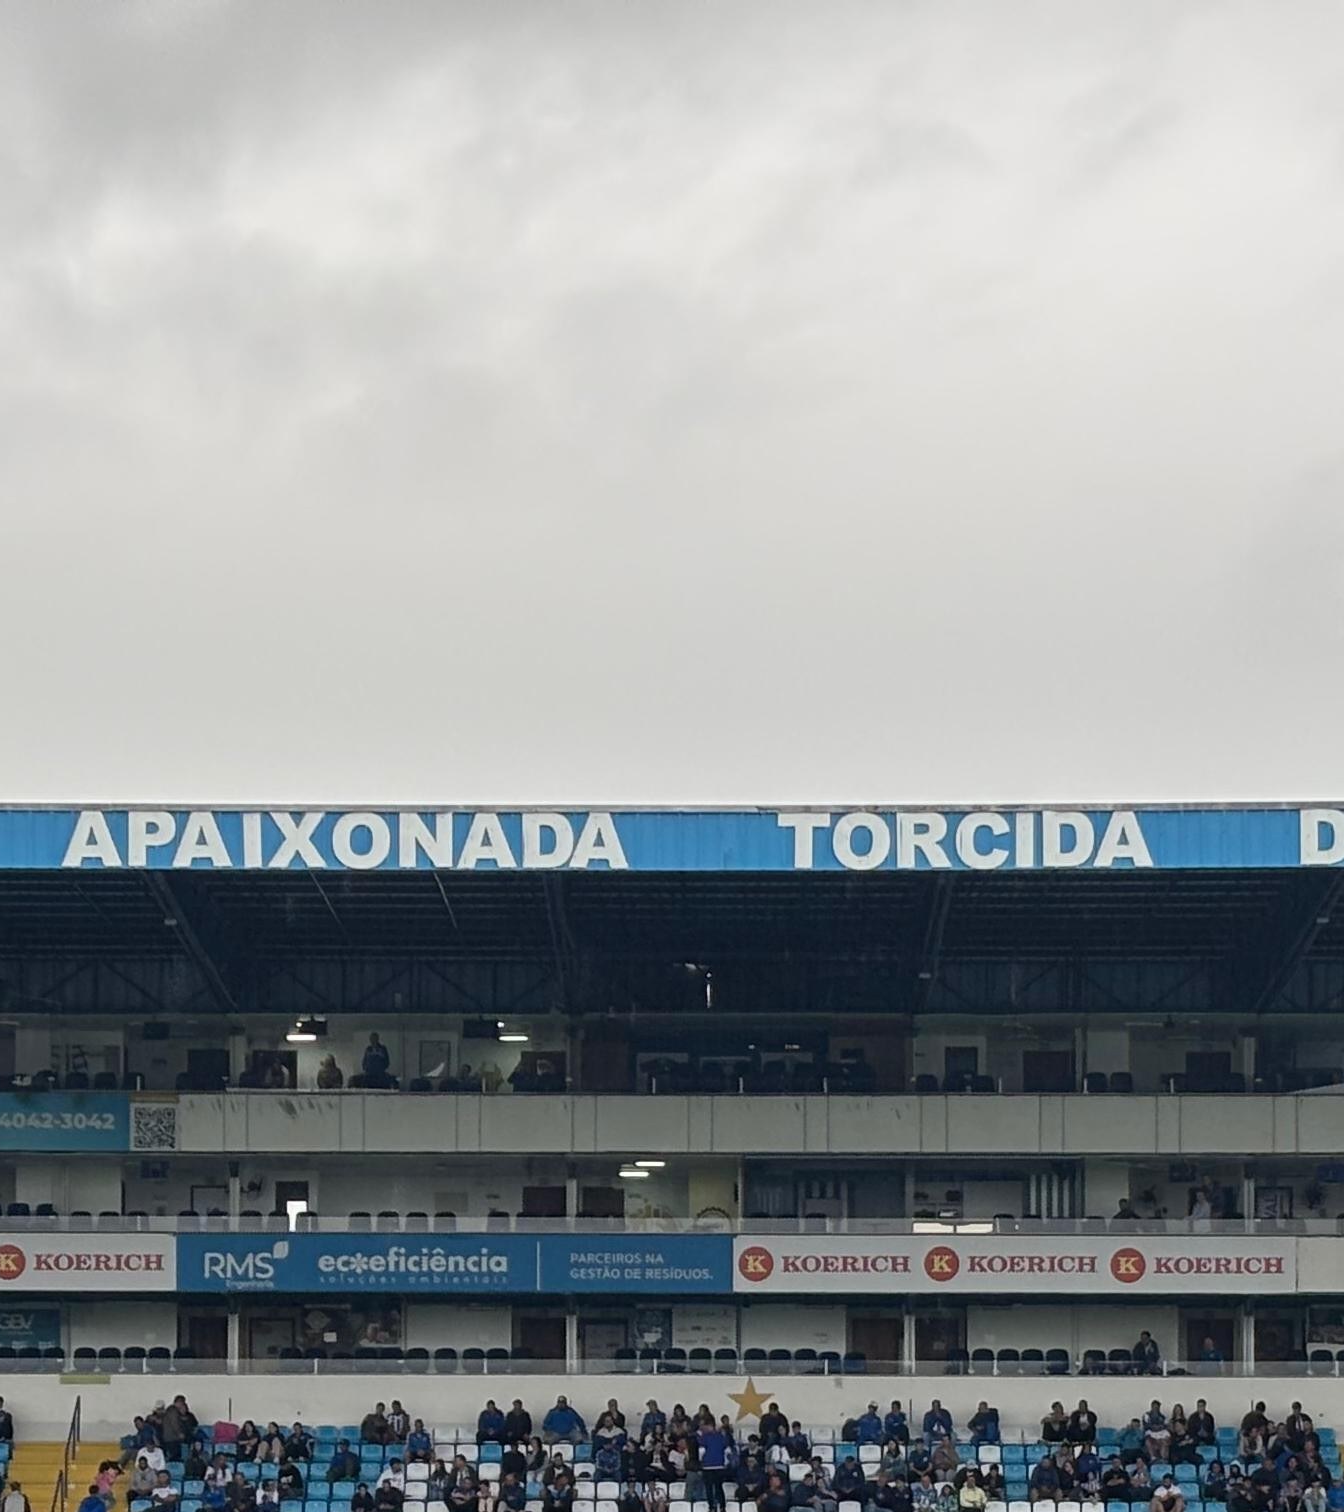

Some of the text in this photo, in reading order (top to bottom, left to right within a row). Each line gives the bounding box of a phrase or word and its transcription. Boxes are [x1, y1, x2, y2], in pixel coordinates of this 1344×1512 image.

[62, 807, 628, 871] APAIXONADA
[777, 807, 1154, 872] TORCIDA
[32, 1252, 165, 1272] KOERICH
[204, 1252, 274, 1279] RMS
[570, 1253, 664, 1264] PARCEIROS NA
[782, 1255, 911, 1274] KOERICH
[967, 1255, 1098, 1274] KOERICH
[1153, 1256, 1285, 1275] KOERICH
[570, 1266, 621, 1279] GESTÃO
[624, 1268, 641, 1279] DE
